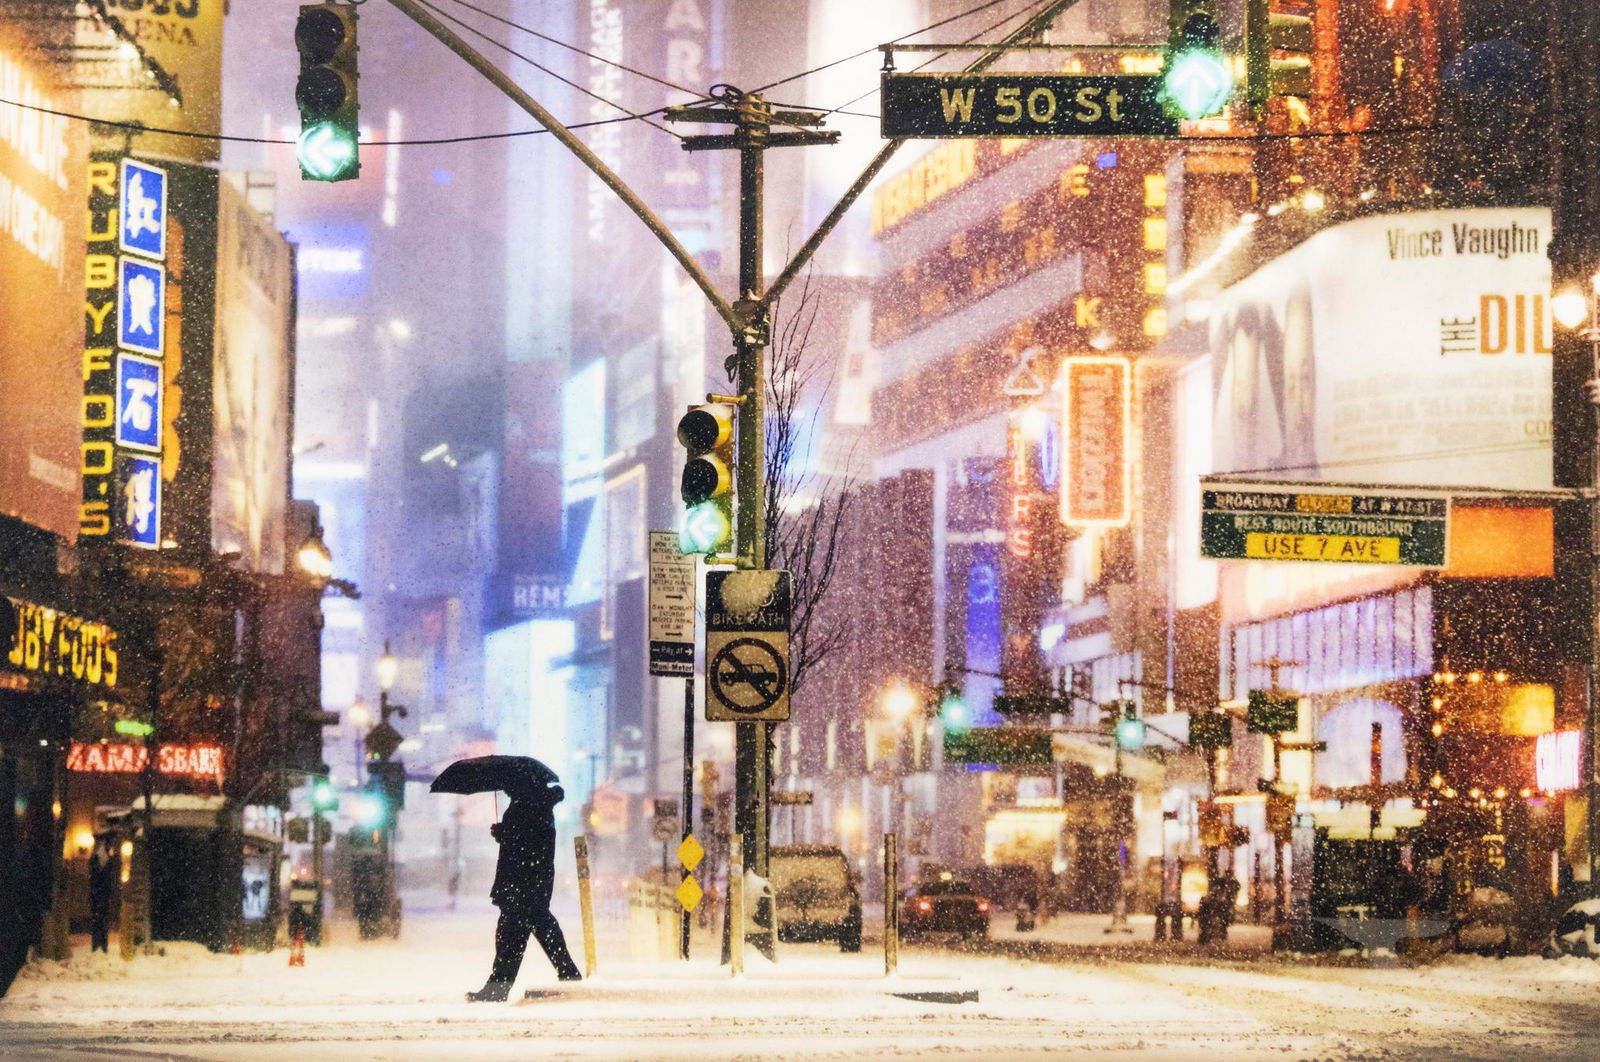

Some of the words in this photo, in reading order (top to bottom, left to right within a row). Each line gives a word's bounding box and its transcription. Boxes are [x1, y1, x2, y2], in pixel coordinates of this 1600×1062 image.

[940, 88, 975, 122] W
[996, 87, 1057, 123] 50
[1075, 87, 1123, 122] St
[84, 162, 117, 335] RUBY
[1387, 227, 1442, 260] Vince
[1452, 221, 1539, 260] Vaughn
[1440, 316, 1476, 356] THE
[79, 347, 115, 537] FOO'S
[1215, 494, 1290, 509] BROADWAY
[1235, 515, 1267, 532] BEST
[1271, 516, 1316, 533] ROUTE
[1323, 520, 1412, 536] SOUTHBOUND
[1264, 536, 1304, 555] USE
[1317, 538, 1328, 556] 7
[1341, 540, 1380, 557] AVE
[712, 613, 743, 625] BIKE
[748, 610, 784, 626] PATH
